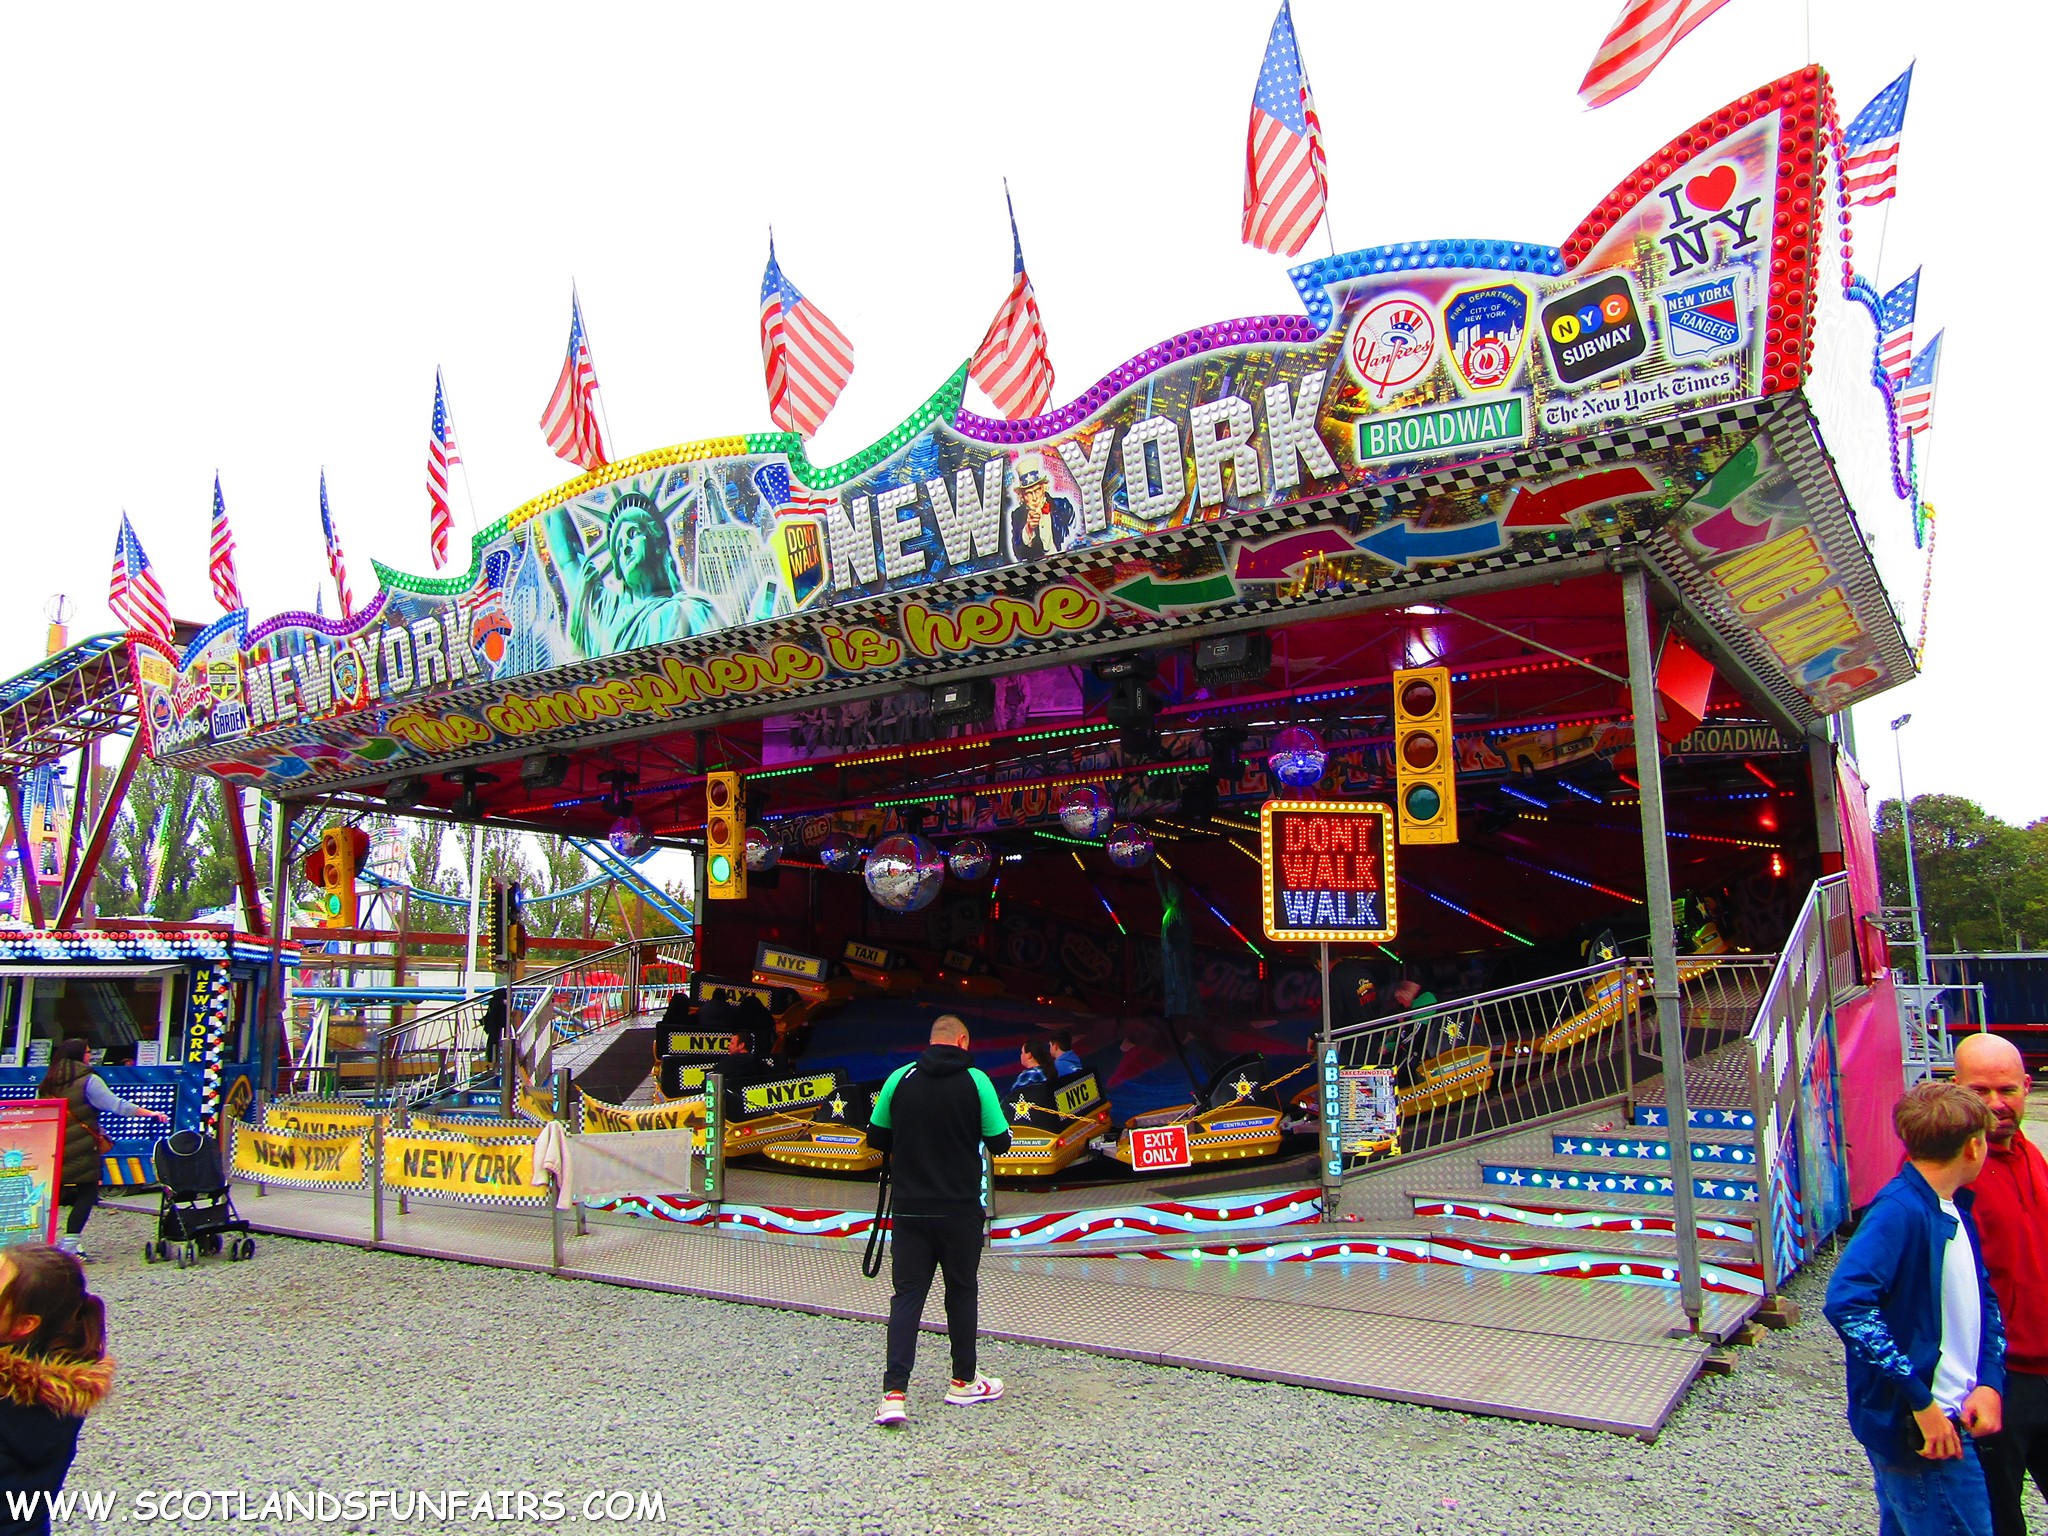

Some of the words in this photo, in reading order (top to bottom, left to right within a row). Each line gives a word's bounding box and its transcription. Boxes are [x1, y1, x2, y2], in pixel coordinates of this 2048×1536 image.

[1659, 183, 1693, 230] I
[1659, 196, 1761, 277] NY
[1450, 303, 1466, 320] FIRE
[1468, 291, 1522, 309] DEPARTMENT
[1470, 306, 1487, 315] CITY
[1491, 304, 1502, 312] OF
[1668, 294, 1694, 312] NEW
[1699, 284, 1732, 304] YORK
[1465, 313, 1482, 323] NEW
[1485, 310, 1507, 319] YORK
[1557, 300, 1622, 338] NYC
[1680, 312, 1735, 342] RANGERS
[1353, 336, 1435, 374] Yankees
[1562, 325, 1632, 366] SUBWAY
[1546, 404, 1579, 425] The
[1582, 395, 1620, 419] New
[1623, 384, 1670, 412] York
[1672, 371, 1731, 397] Times
[1369, 402, 1514, 458] BROADWAY
[826, 459, 1004, 593] NEW
[1059, 369, 1340, 535] YORK
[787, 525, 815, 554] DONT
[790, 544, 820, 579] WALK
[1709, 525, 1831, 615] NYC
[1754, 585, 1863, 667] TAXI
[245, 643, 331, 727] NEW
[352, 606, 481, 701] YORK
[388, 713, 491, 753] The
[488, 645, 826, 737] atmosphere
[820, 625, 899, 672] is
[902, 582, 1103, 658] here
[213, 707, 248, 737] GARDEN
[1680, 728, 1788, 754] BROADWA
[1285, 817, 1373, 852] DONT
[1282, 854, 1377, 888] WALK
[1282, 890, 1379, 925] WALK
[777, 955, 806, 972] NYC
[854, 945, 879, 962] TAXI
[192, 969, 210, 1006] NEW
[188, 1012, 207, 1063] YORK
[766, 1081, 815, 1105] NYC
[1065, 1083, 1090, 1109] NYC
[595, 1107, 631, 1132] THIS
[636, 1111, 679, 1130] WAY
[254, 1140, 296, 1169] NEW
[303, 1143, 347, 1172] YORK
[1142, 1147, 1179, 1164] ONLY
[1143, 1131, 1174, 1148] EXIT
